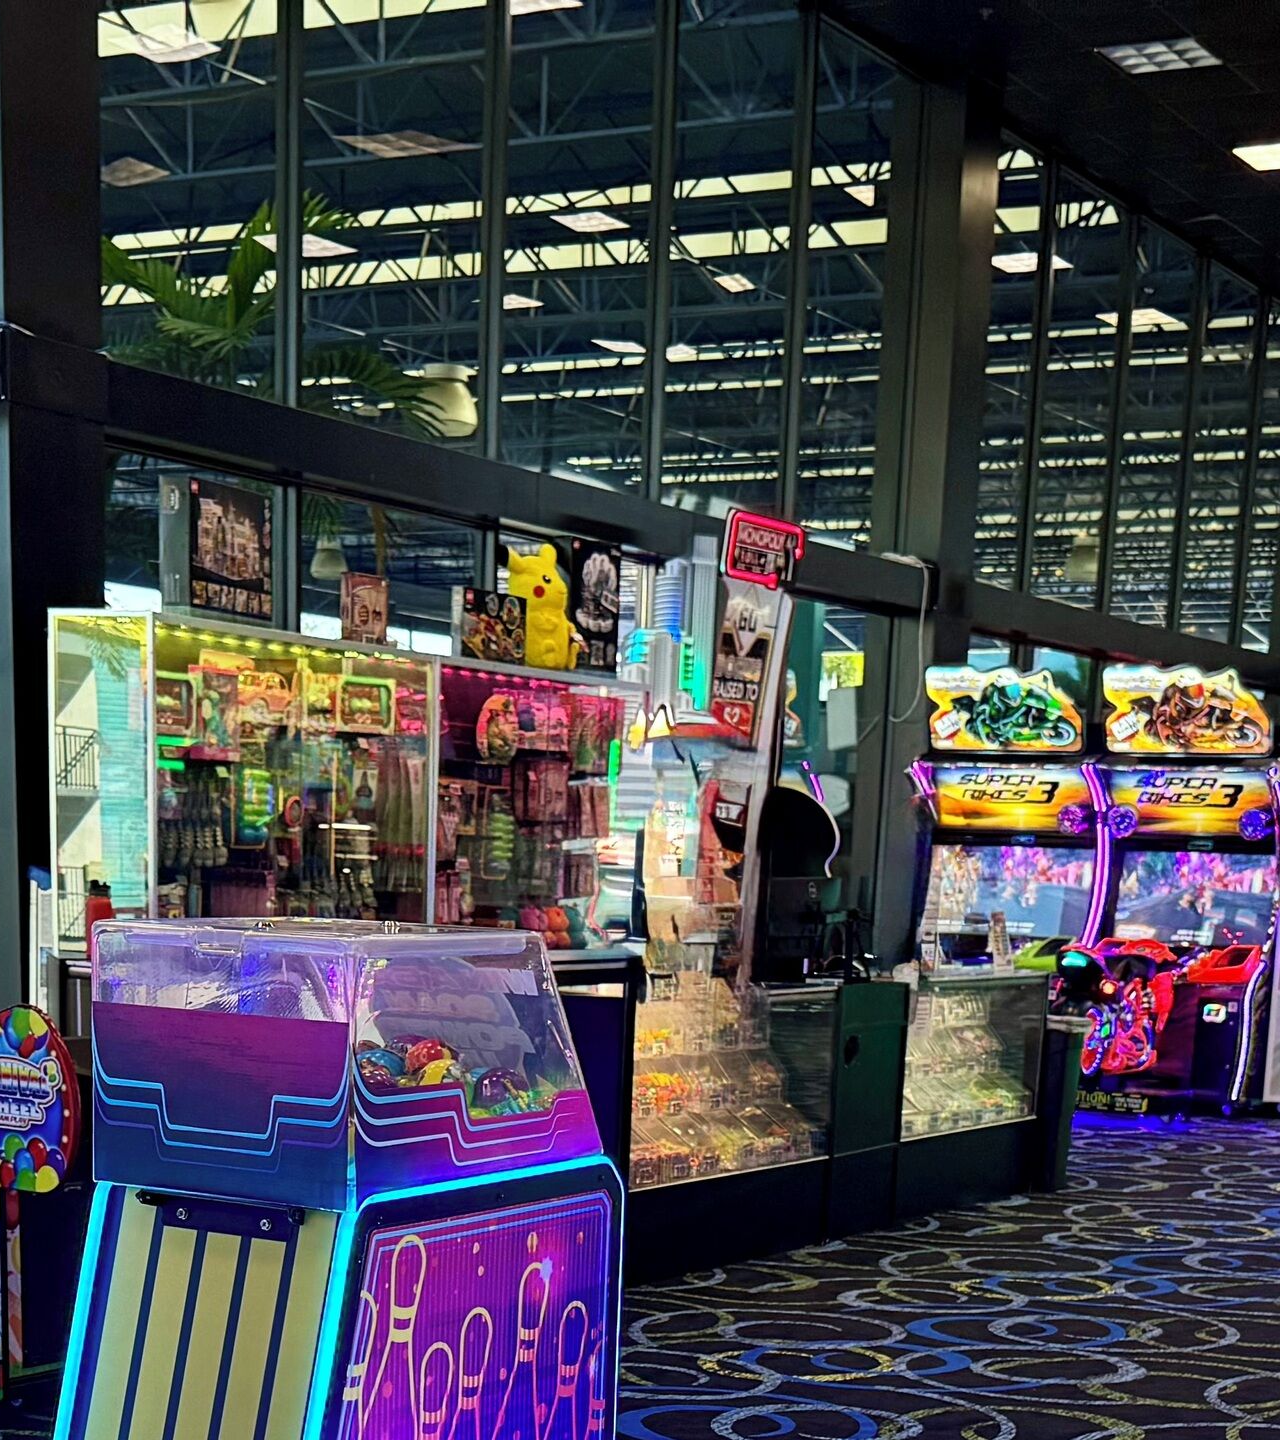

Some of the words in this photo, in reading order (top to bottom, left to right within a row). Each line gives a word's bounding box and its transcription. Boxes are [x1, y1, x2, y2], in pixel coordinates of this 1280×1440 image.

[957, 773, 1035, 787] SUPER
[1134, 775, 1218, 789] SUPER
[1036, 781, 1060, 803] 3
[1219, 784, 1244, 808] 3
[1077, 1090, 1110, 1105] TION!
